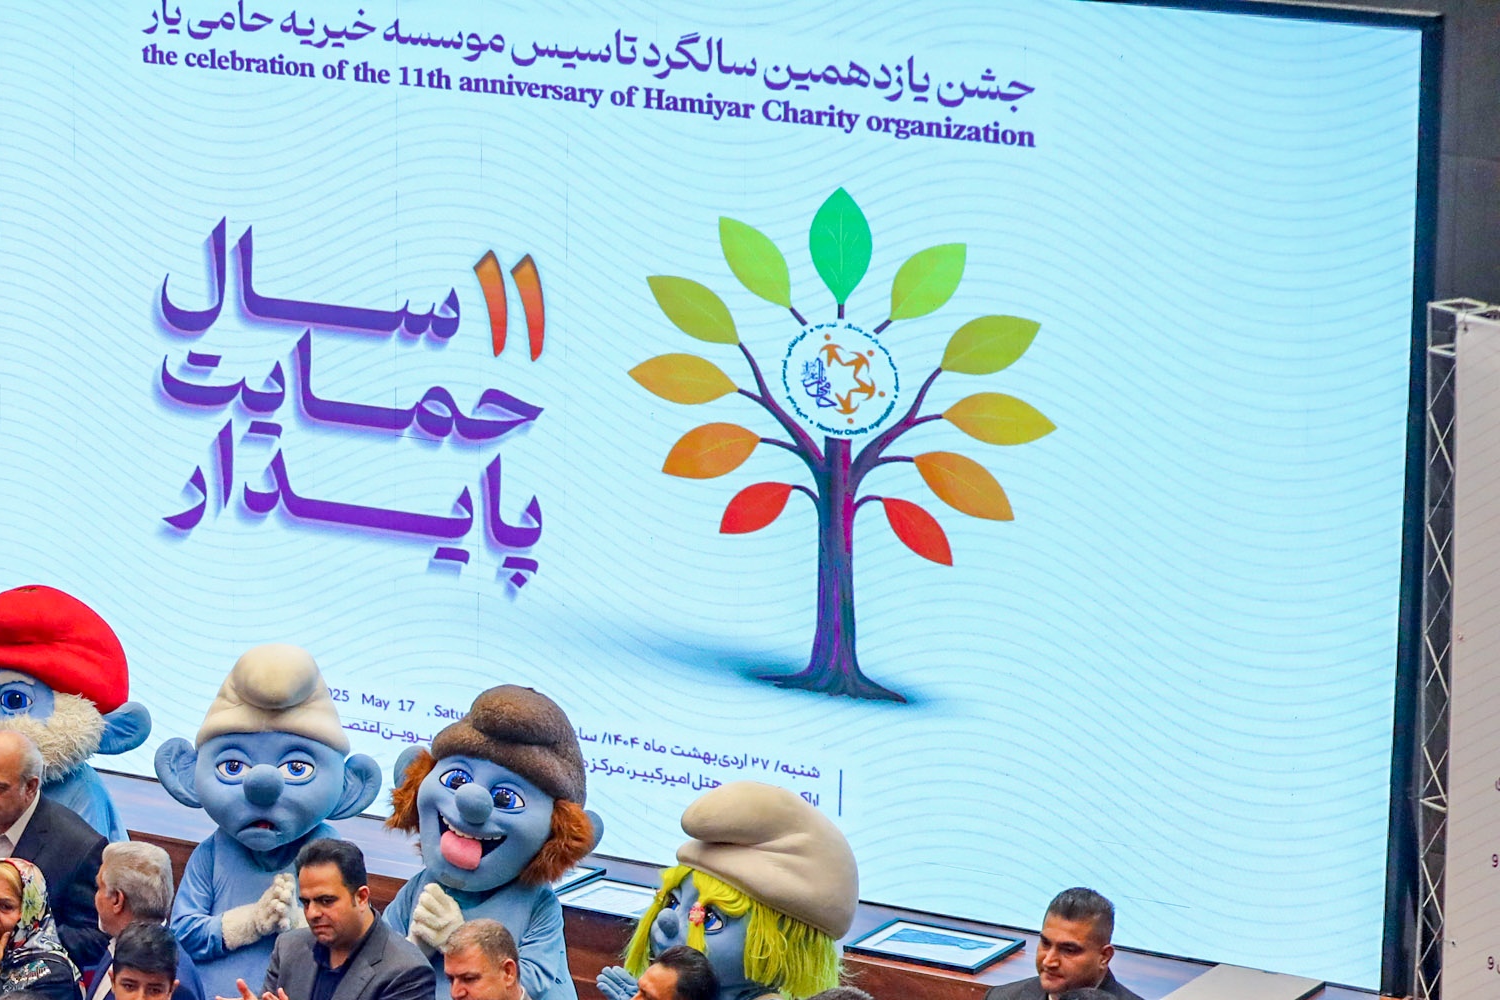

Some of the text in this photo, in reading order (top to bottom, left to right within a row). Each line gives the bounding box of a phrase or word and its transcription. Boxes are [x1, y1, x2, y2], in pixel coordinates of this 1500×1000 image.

[280, 9, 377, 49] خیریه
[383, 18, 505, 62] موسسه
[511, 28, 637, 69] تاسیس
[643, 32, 757, 79] سالگرد
[142, 43, 1036, 148] the celebration of the 11th anniversary of Hamiyar Charity organization
[763, 55, 930, 102] یازدهمین
[937, 68, 1036, 113] جشن
[160, 215, 545, 362] ۱۱ سال
[160, 327, 545, 441] حمایت
[161, 418, 543, 589] پایدار
[328, 688, 466, 720] 25 May 17 Satu
[575, 728, 597, 742] سا
[644, 739, 667, 754] ماه
[590, 758, 625, 775] مرکز
[751, 758, 769, 770] ۲۷
